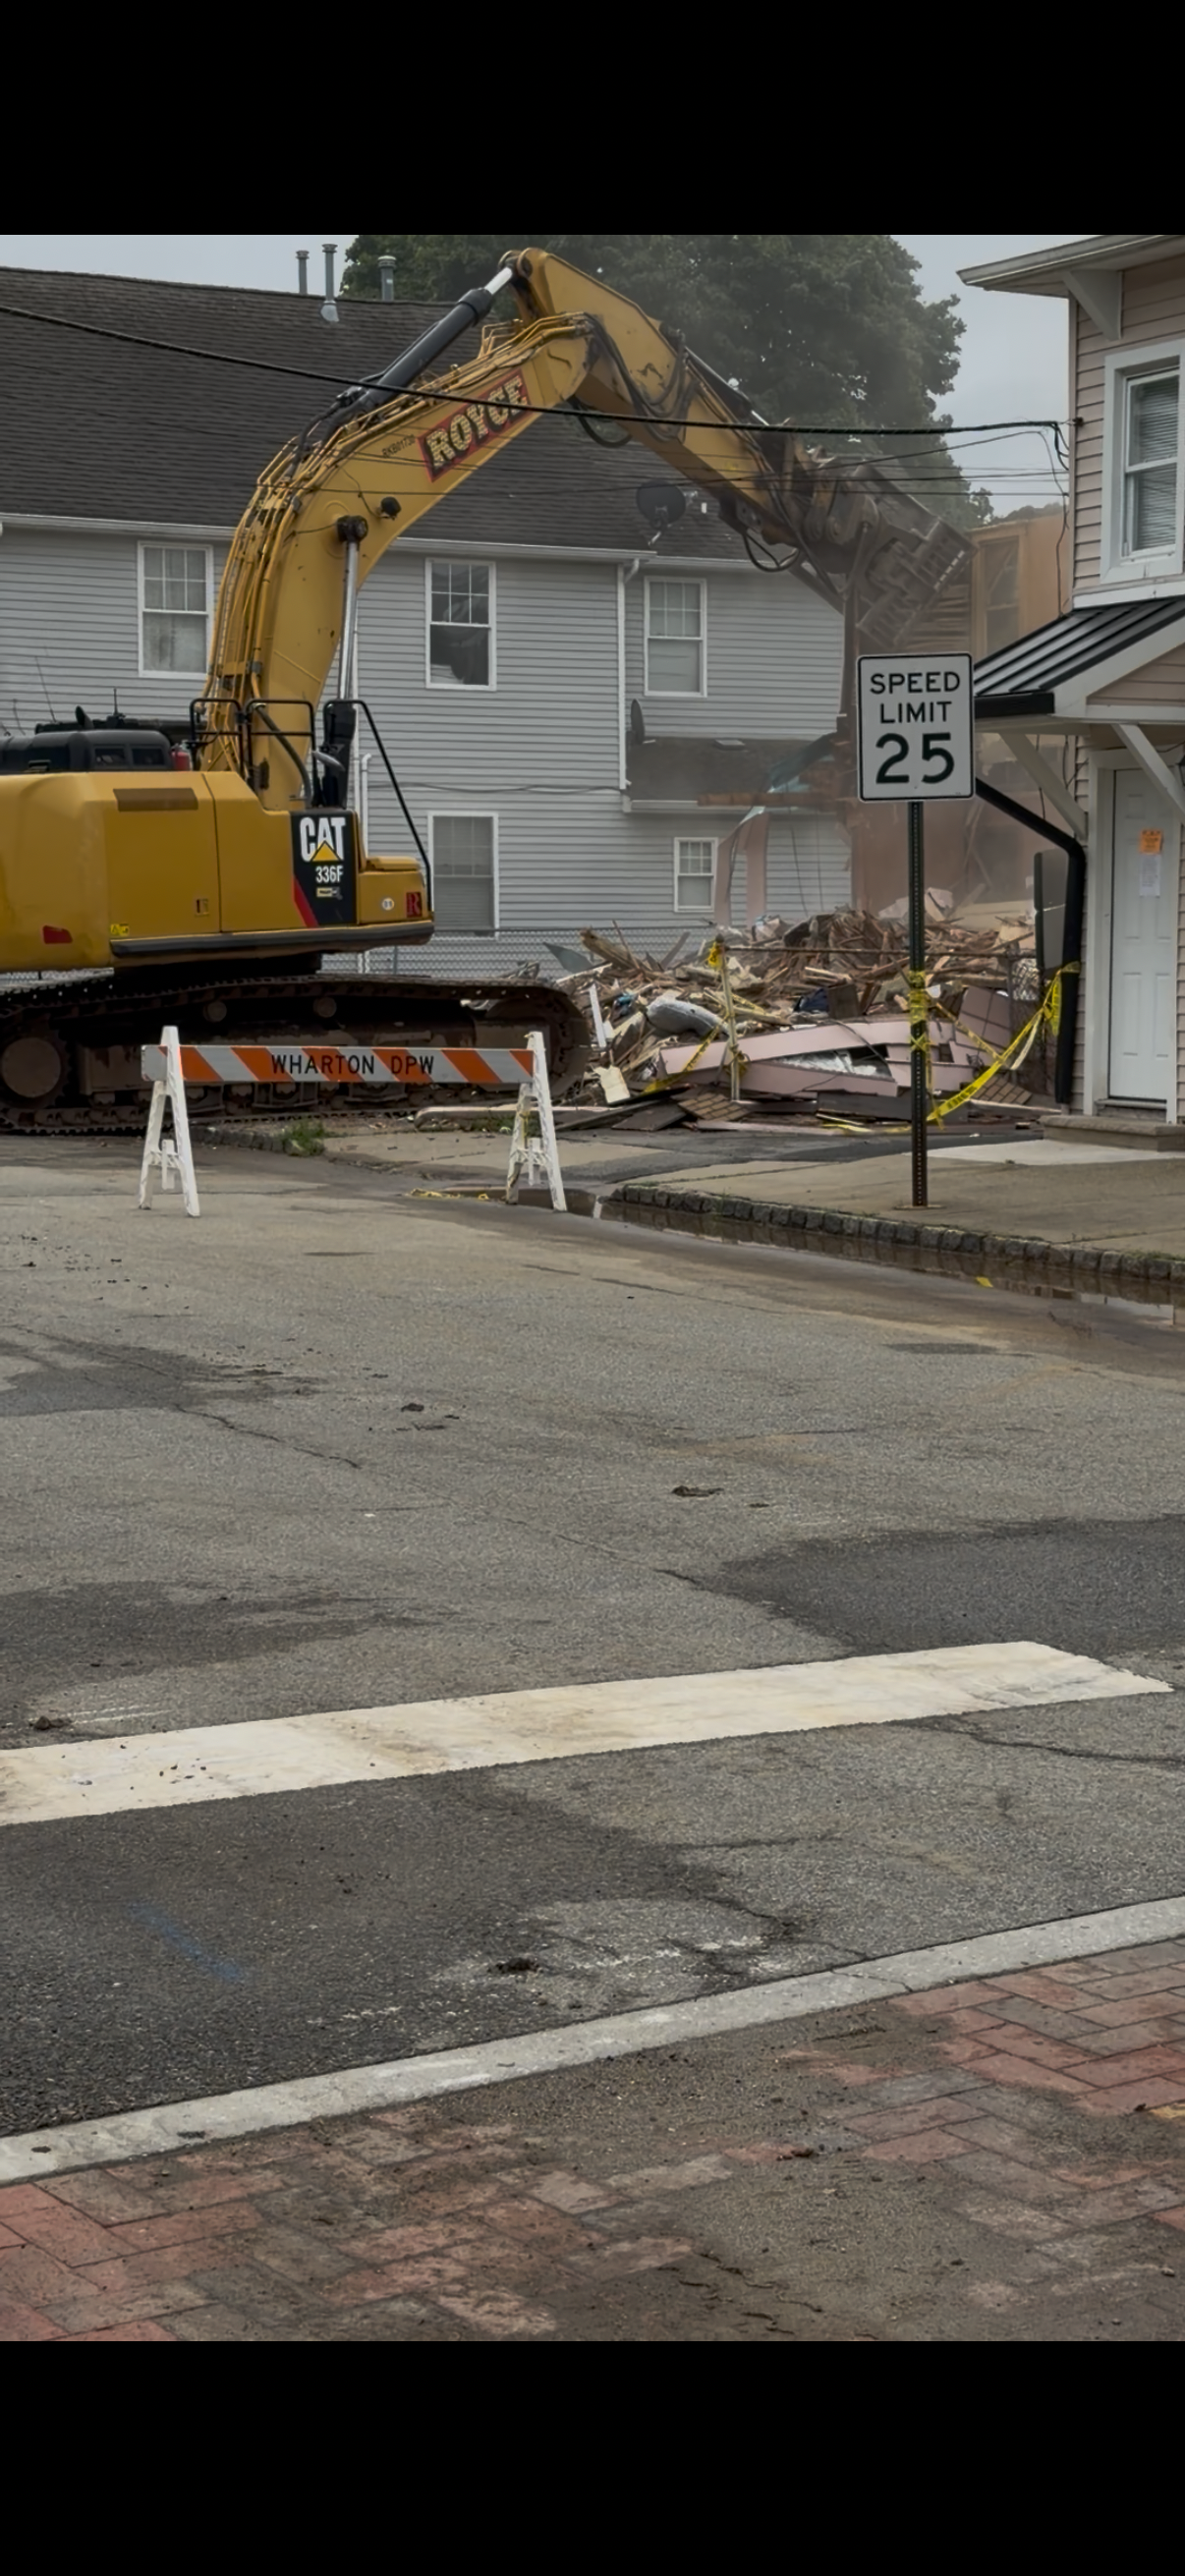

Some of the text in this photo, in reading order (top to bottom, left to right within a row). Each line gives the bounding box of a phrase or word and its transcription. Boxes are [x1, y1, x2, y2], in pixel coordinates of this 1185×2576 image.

[425, 374, 529, 469] ROYCE
[870, 671, 960, 695] SPEED
[880, 700, 952, 724] LIMIT
[875, 732, 955, 784] 25
[300, 816, 346, 863] CAT
[315, 866, 343, 883] 336F
[271, 1054, 434, 1075] WHARTON DPW
